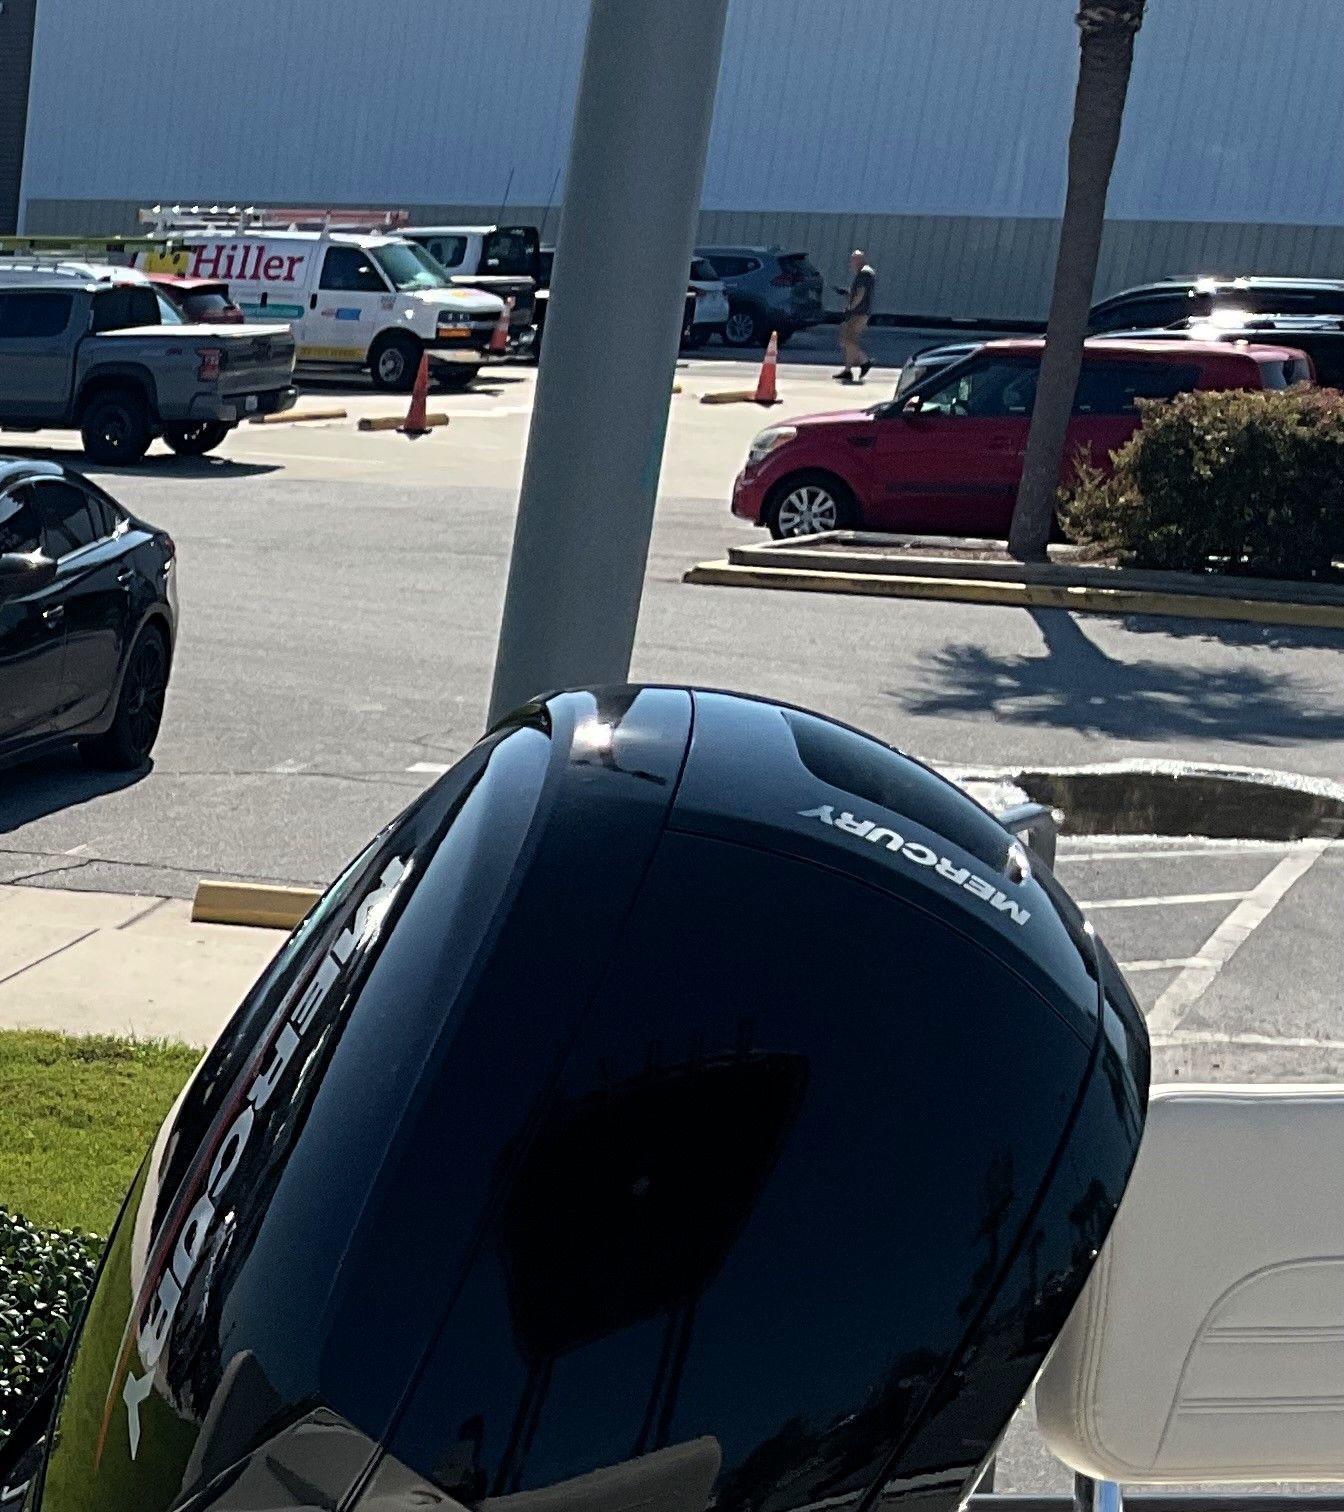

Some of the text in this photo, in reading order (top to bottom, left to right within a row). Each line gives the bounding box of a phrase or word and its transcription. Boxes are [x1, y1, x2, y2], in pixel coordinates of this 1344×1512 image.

[191, 244, 305, 281] Hiller
[796, 804, 1031, 926] MERCURY
[122, 854, 414, 1461] MERCURY
